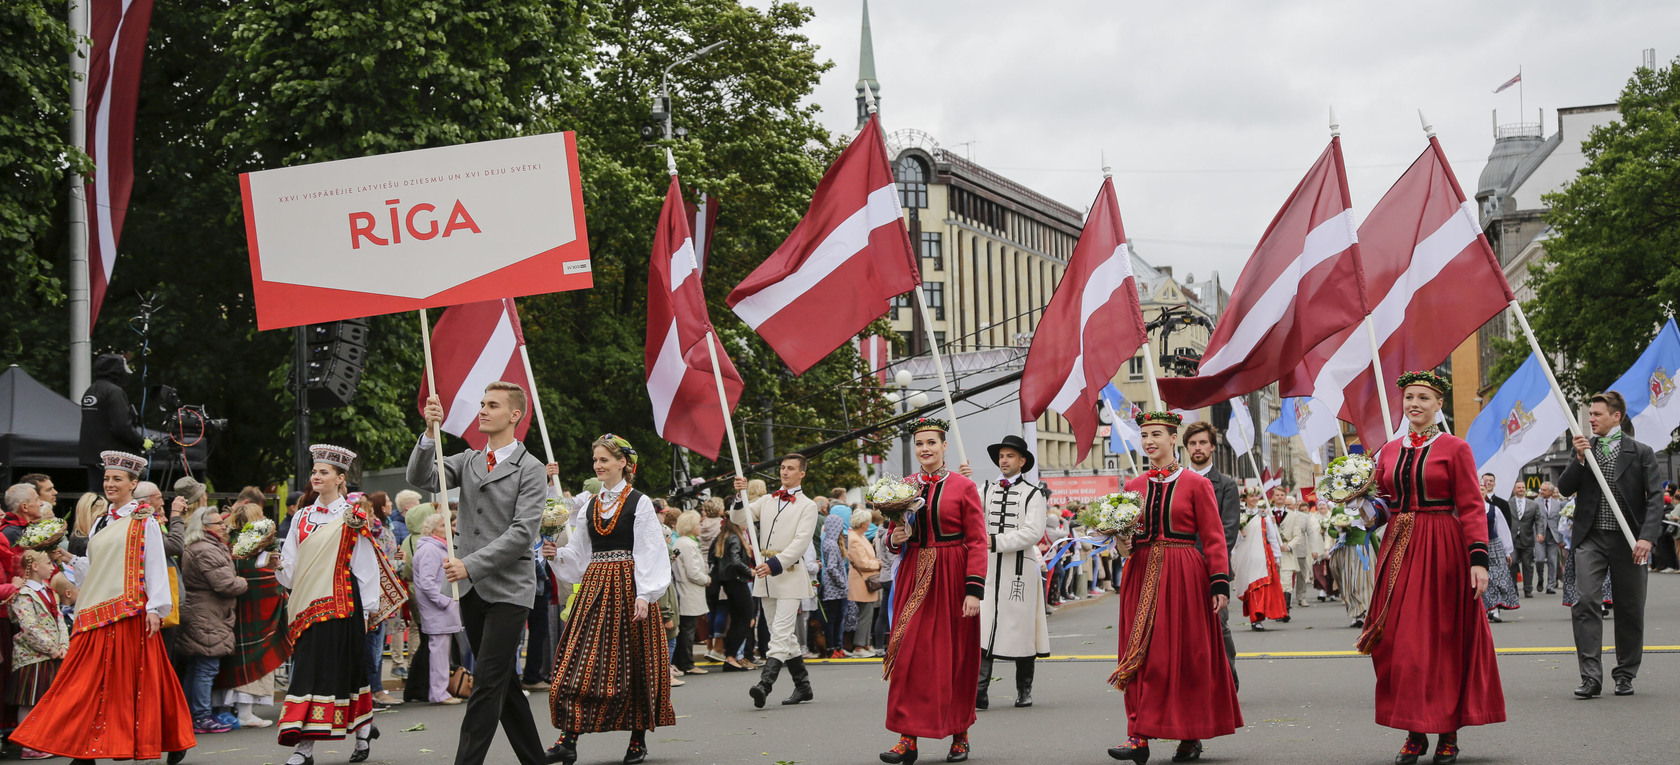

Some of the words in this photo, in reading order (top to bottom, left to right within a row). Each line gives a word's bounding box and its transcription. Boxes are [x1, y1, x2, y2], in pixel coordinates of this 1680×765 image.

[279, 195, 299, 204] XXVI
[302, 187, 353, 200] VISPĀRĒJIE
[357, 181, 399, 193] LATVIEŠU
[403, 175, 444, 187] DZIESMU
[448, 173, 461, 181] UN
[465, 171, 480, 179] XVI
[484, 168, 506, 176] DEJU
[510, 163, 542, 173] SVĒTKI
[348, 199, 482, 249] RĪGA
